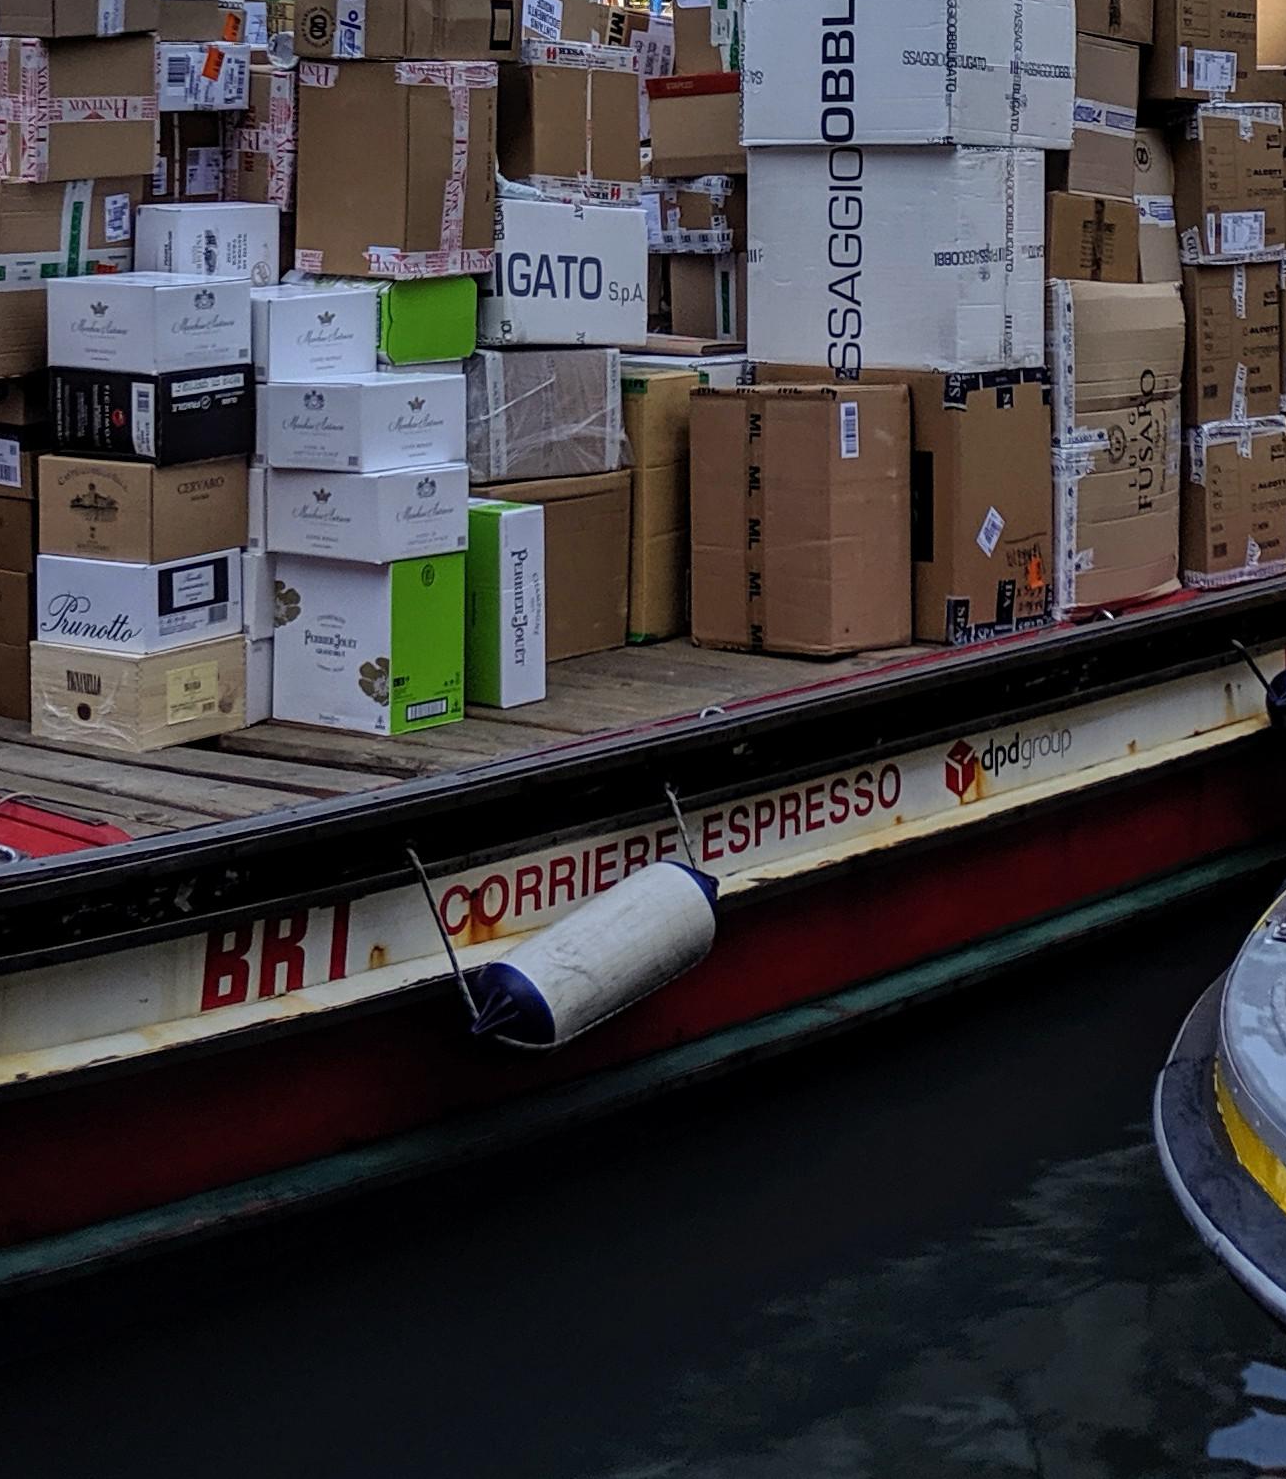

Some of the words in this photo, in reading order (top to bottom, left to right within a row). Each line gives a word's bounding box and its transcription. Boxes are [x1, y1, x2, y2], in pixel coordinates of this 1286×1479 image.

[69, 98, 128, 119] PINTINOX
[827, 146, 865, 369] SSAGGIO
[747, 413, 762, 445] ML
[1137, 368, 1157, 512] FUSARO
[177, 476, 226, 495] CERVARO
[747, 465, 762, 497] ML
[747, 518, 762, 550] ML
[747, 571, 762, 603] ML
[40, 593, 143, 643] Prunotto
[981, 727, 1072, 778] dpdgroup
[439, 826, 677, 938] CORRIERE
[701, 763, 903, 863] ESPRESSO
[201, 901, 352, 1012] BRT
